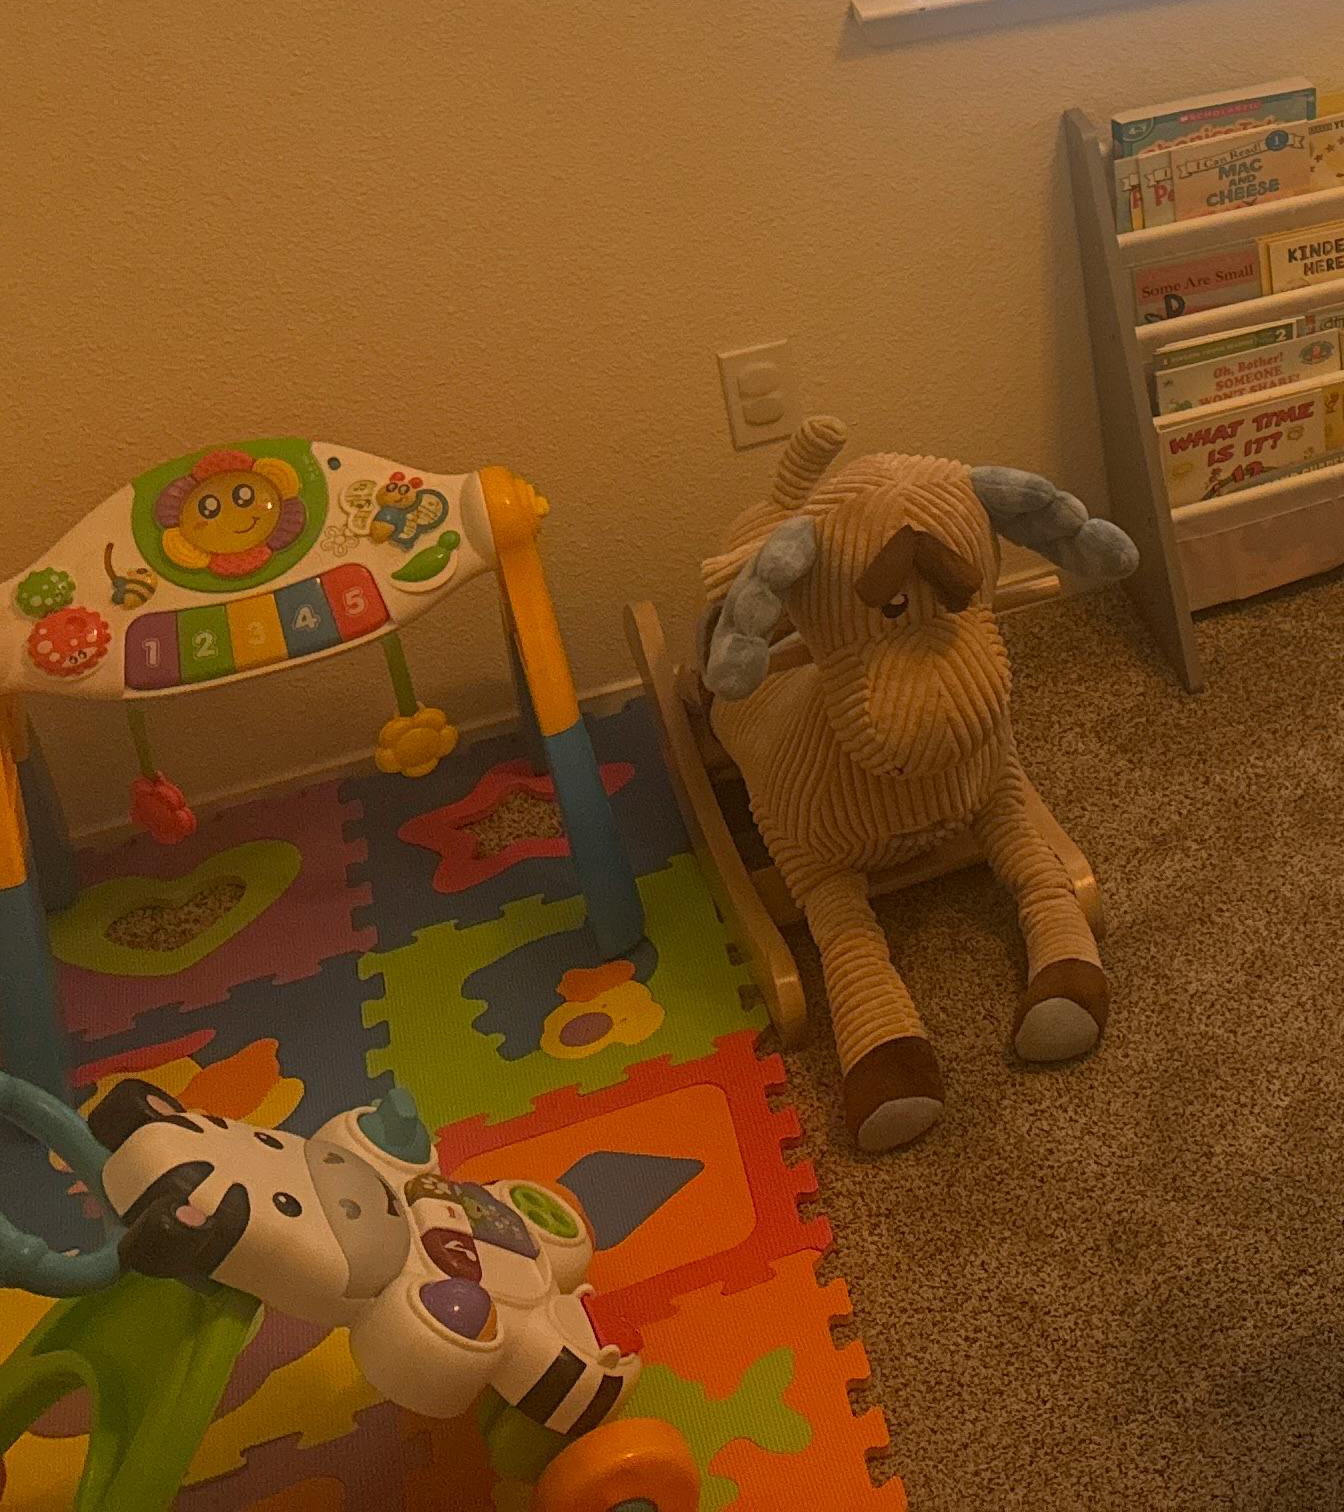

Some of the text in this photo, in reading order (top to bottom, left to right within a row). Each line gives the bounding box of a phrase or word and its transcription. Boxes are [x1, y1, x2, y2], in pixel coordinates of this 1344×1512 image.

[1203, 154, 1231, 169] Can
[1218, 158, 1263, 181] MAC
[1206, 178, 1281, 207] CHEESE
[1228, 174, 1257, 188] AND
[1303, 256, 1344, 276] HERE
[1141, 263, 1255, 300] Some Are Small
[1237, 351, 1284, 373] Bother!
[1215, 365, 1283, 392] SOMEONE
[1169, 400, 1316, 455] WHAT TIME
[1207, 431, 1283, 467] IS IT?
[143, 589, 366, 667] 1 2 3 4 5
